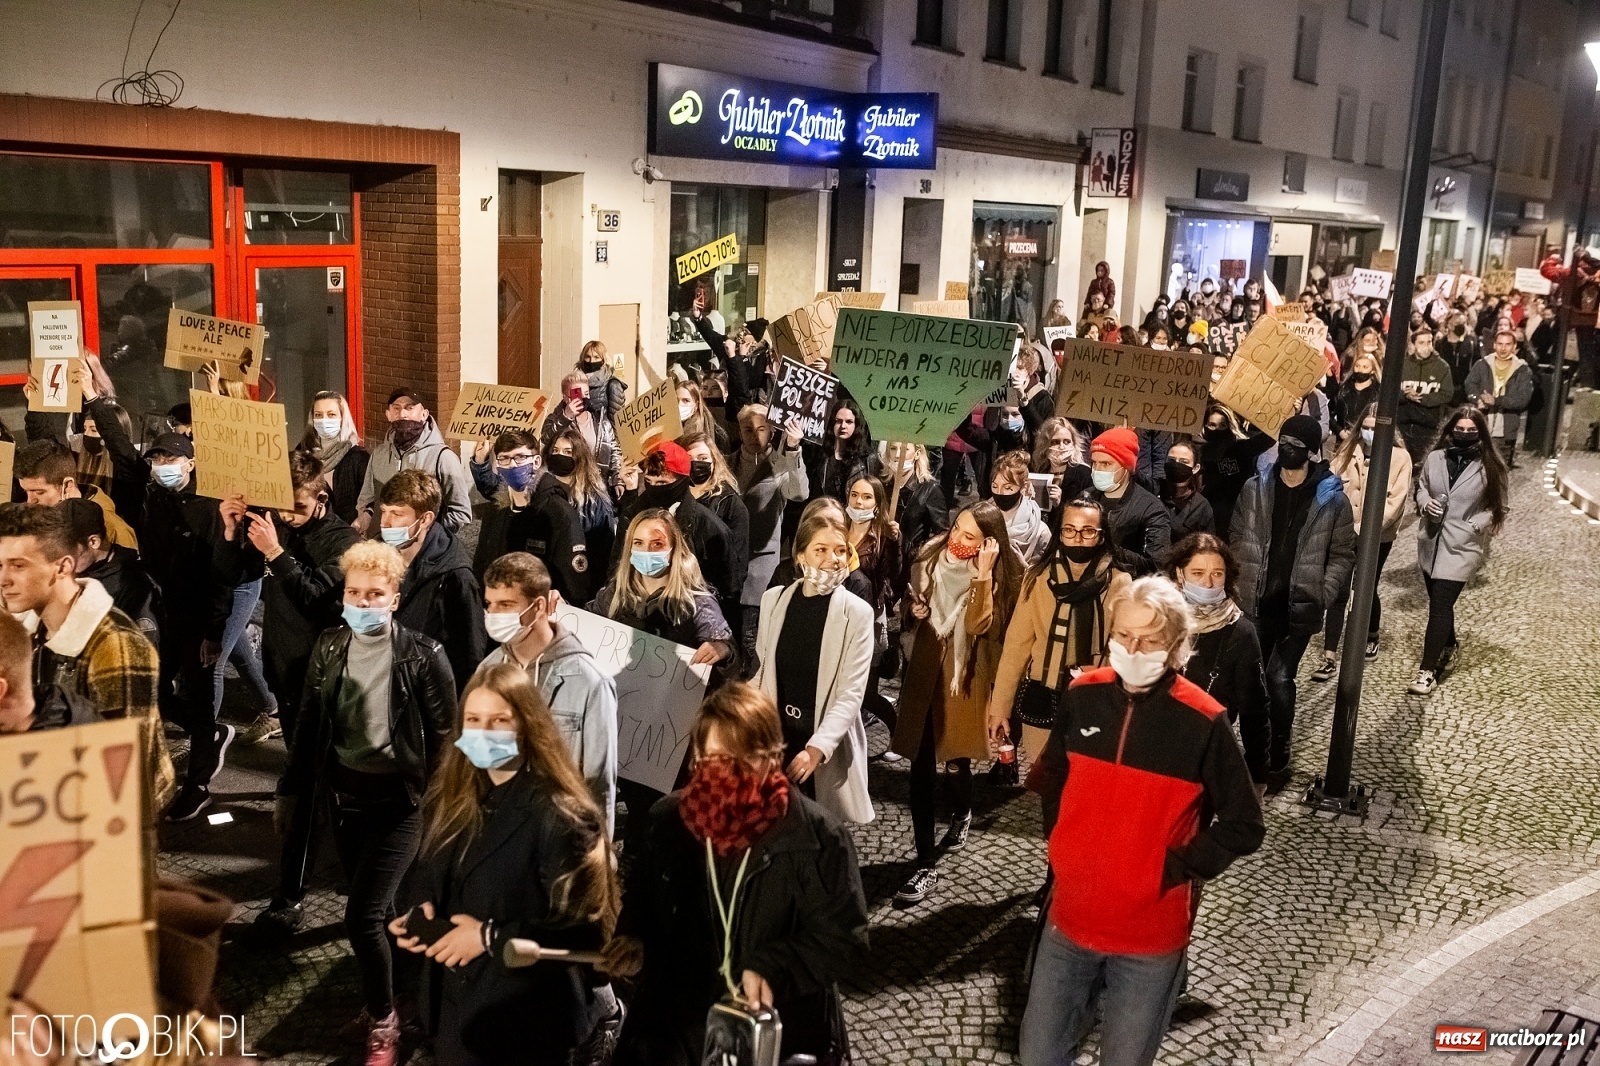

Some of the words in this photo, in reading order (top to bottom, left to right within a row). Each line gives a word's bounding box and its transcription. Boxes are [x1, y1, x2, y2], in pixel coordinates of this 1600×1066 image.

[719, 88, 786, 144] Jubiler
[785, 97, 846, 146] Złotnik
[864, 105, 920, 133] Jubiler
[734, 135, 778, 152] OCZADŁY
[863, 135, 920, 160] Złotnik
[604, 213, 619, 227] 36
[678, 250, 711, 279] ZŁOTO
[712, 238, 736, 262] -10%
[1008, 242, 1038, 254] PRZECENA
[180, 315, 206, 331] LOVE
[207, 320, 216, 332] &
[218, 321, 252, 339] PEACE
[202, 332, 223, 345] ALE
[841, 313, 880, 342] NIE
[889, 315, 1018, 352] POTRZEBUJE
[833, 344, 911, 371] TINDERA
[916, 352, 943, 374] PIS
[948, 357, 1003, 381] RUCHA
[1071, 344, 1125, 368] NAWET
[1132, 353, 1205, 378] MEFEDRON
[1263, 325, 1321, 372] MOJE
[777, 361, 836, 399] JESZCZE
[1250, 343, 1315, 390] CIAŁO
[474, 386, 531, 404] WALCZCIE
[886, 375, 921, 391] NAS
[1071, 368, 1092, 385] MA
[1103, 371, 1156, 394] LEPSZY
[1167, 381, 1208, 401] SKŁAD
[191, 394, 227, 421] MARS
[229, 401, 245, 423] OD
[246, 404, 280, 428] TYŁU
[461, 402, 474, 416] Z
[616, 381, 668, 427] WELCOME
[768, 404, 784, 424] NIE
[781, 386, 803, 409] POL
[811, 395, 828, 418] KA
[868, 395, 960, 415] CODZIENNIE
[1090, 396, 1128, 418] NIŻ
[1141, 403, 1198, 429] RZĄD
[449, 421, 470, 433] NIE
[469, 422, 478, 435] Z
[627, 418, 641, 436] TO
[643, 404, 666, 429] HELL
[192, 420, 210, 441] TO
[243, 430, 250, 451] A
[255, 431, 282, 461] PIS
[195, 443, 211, 463] OD
[240, 454, 276, 479] JEST
